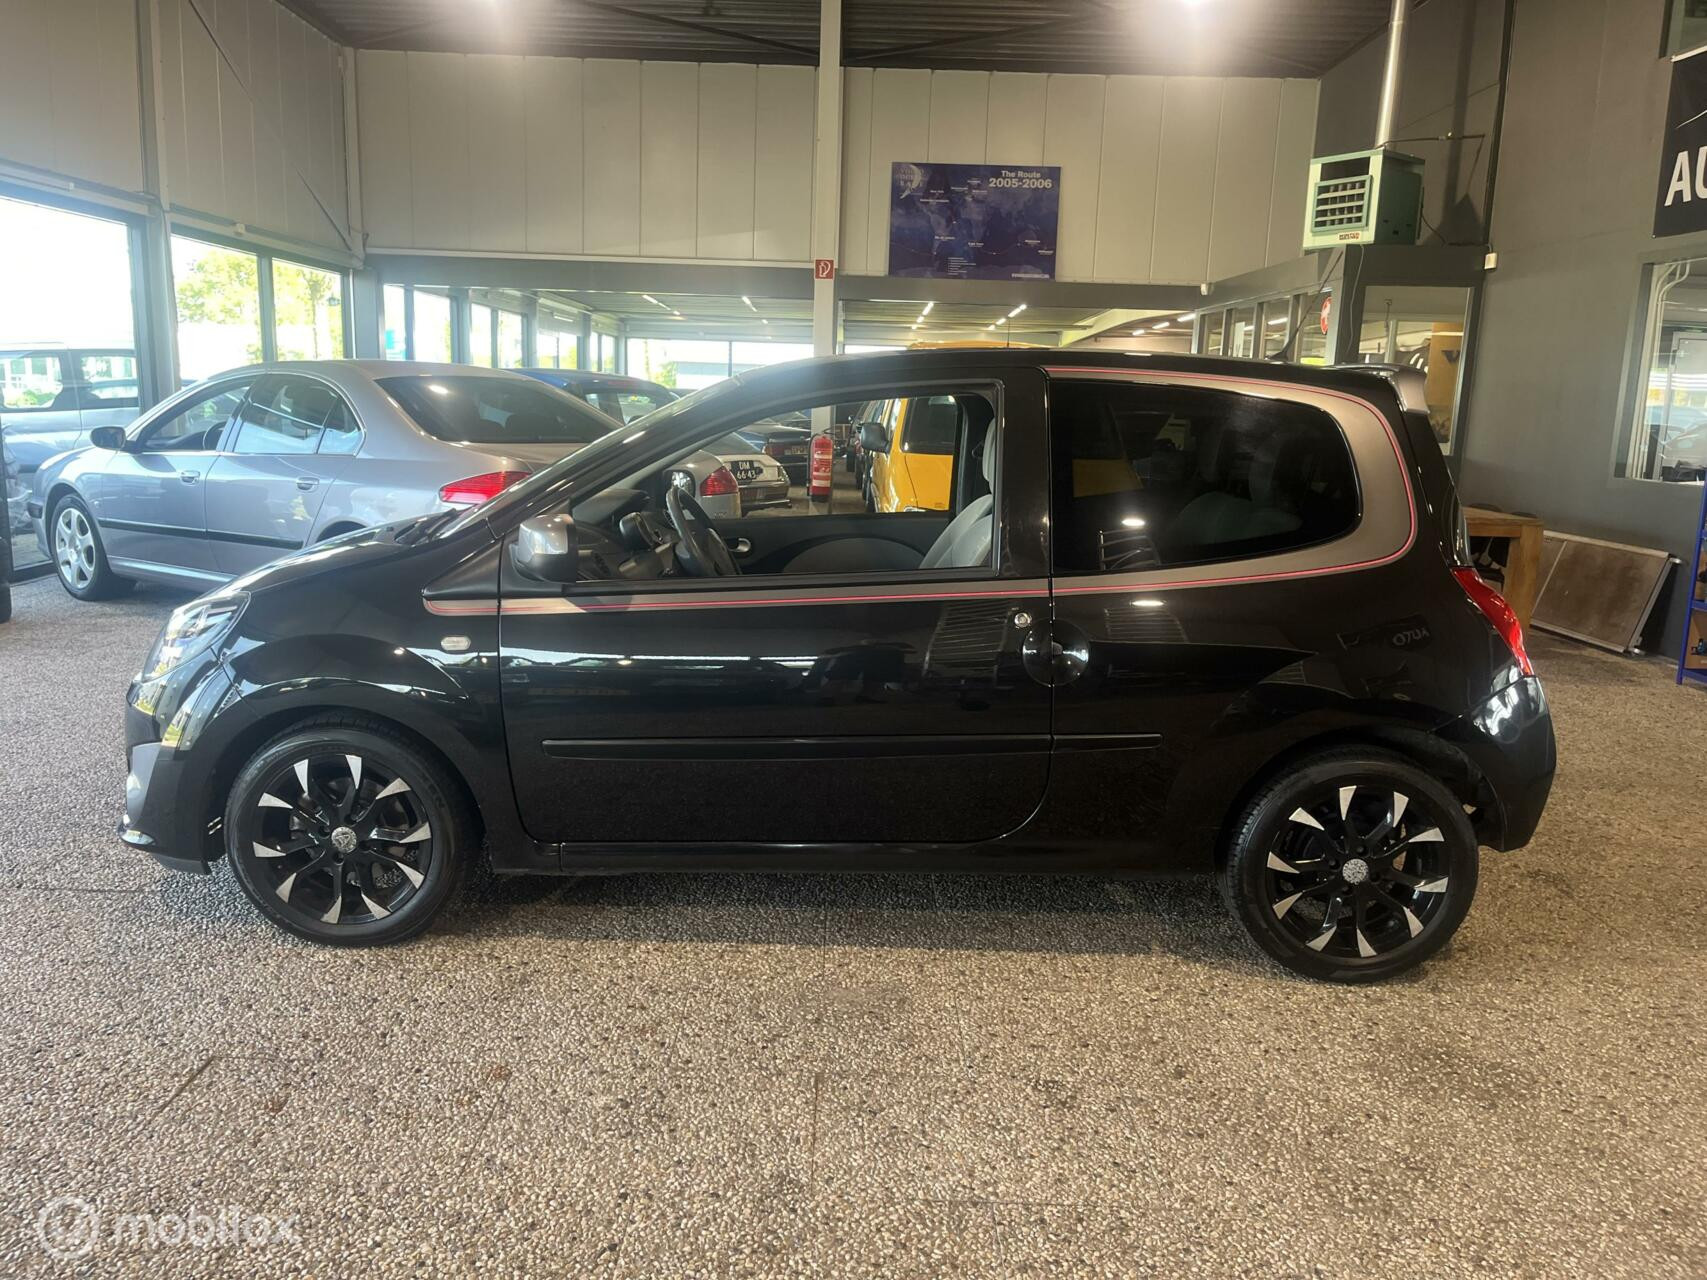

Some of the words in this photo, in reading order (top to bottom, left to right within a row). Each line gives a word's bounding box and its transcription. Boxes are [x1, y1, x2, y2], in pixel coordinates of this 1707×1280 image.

[1001, 170, 1016, 178] The
[1017, 170, 1042, 179] Route
[989, 177, 1053, 189] 2005-2006
